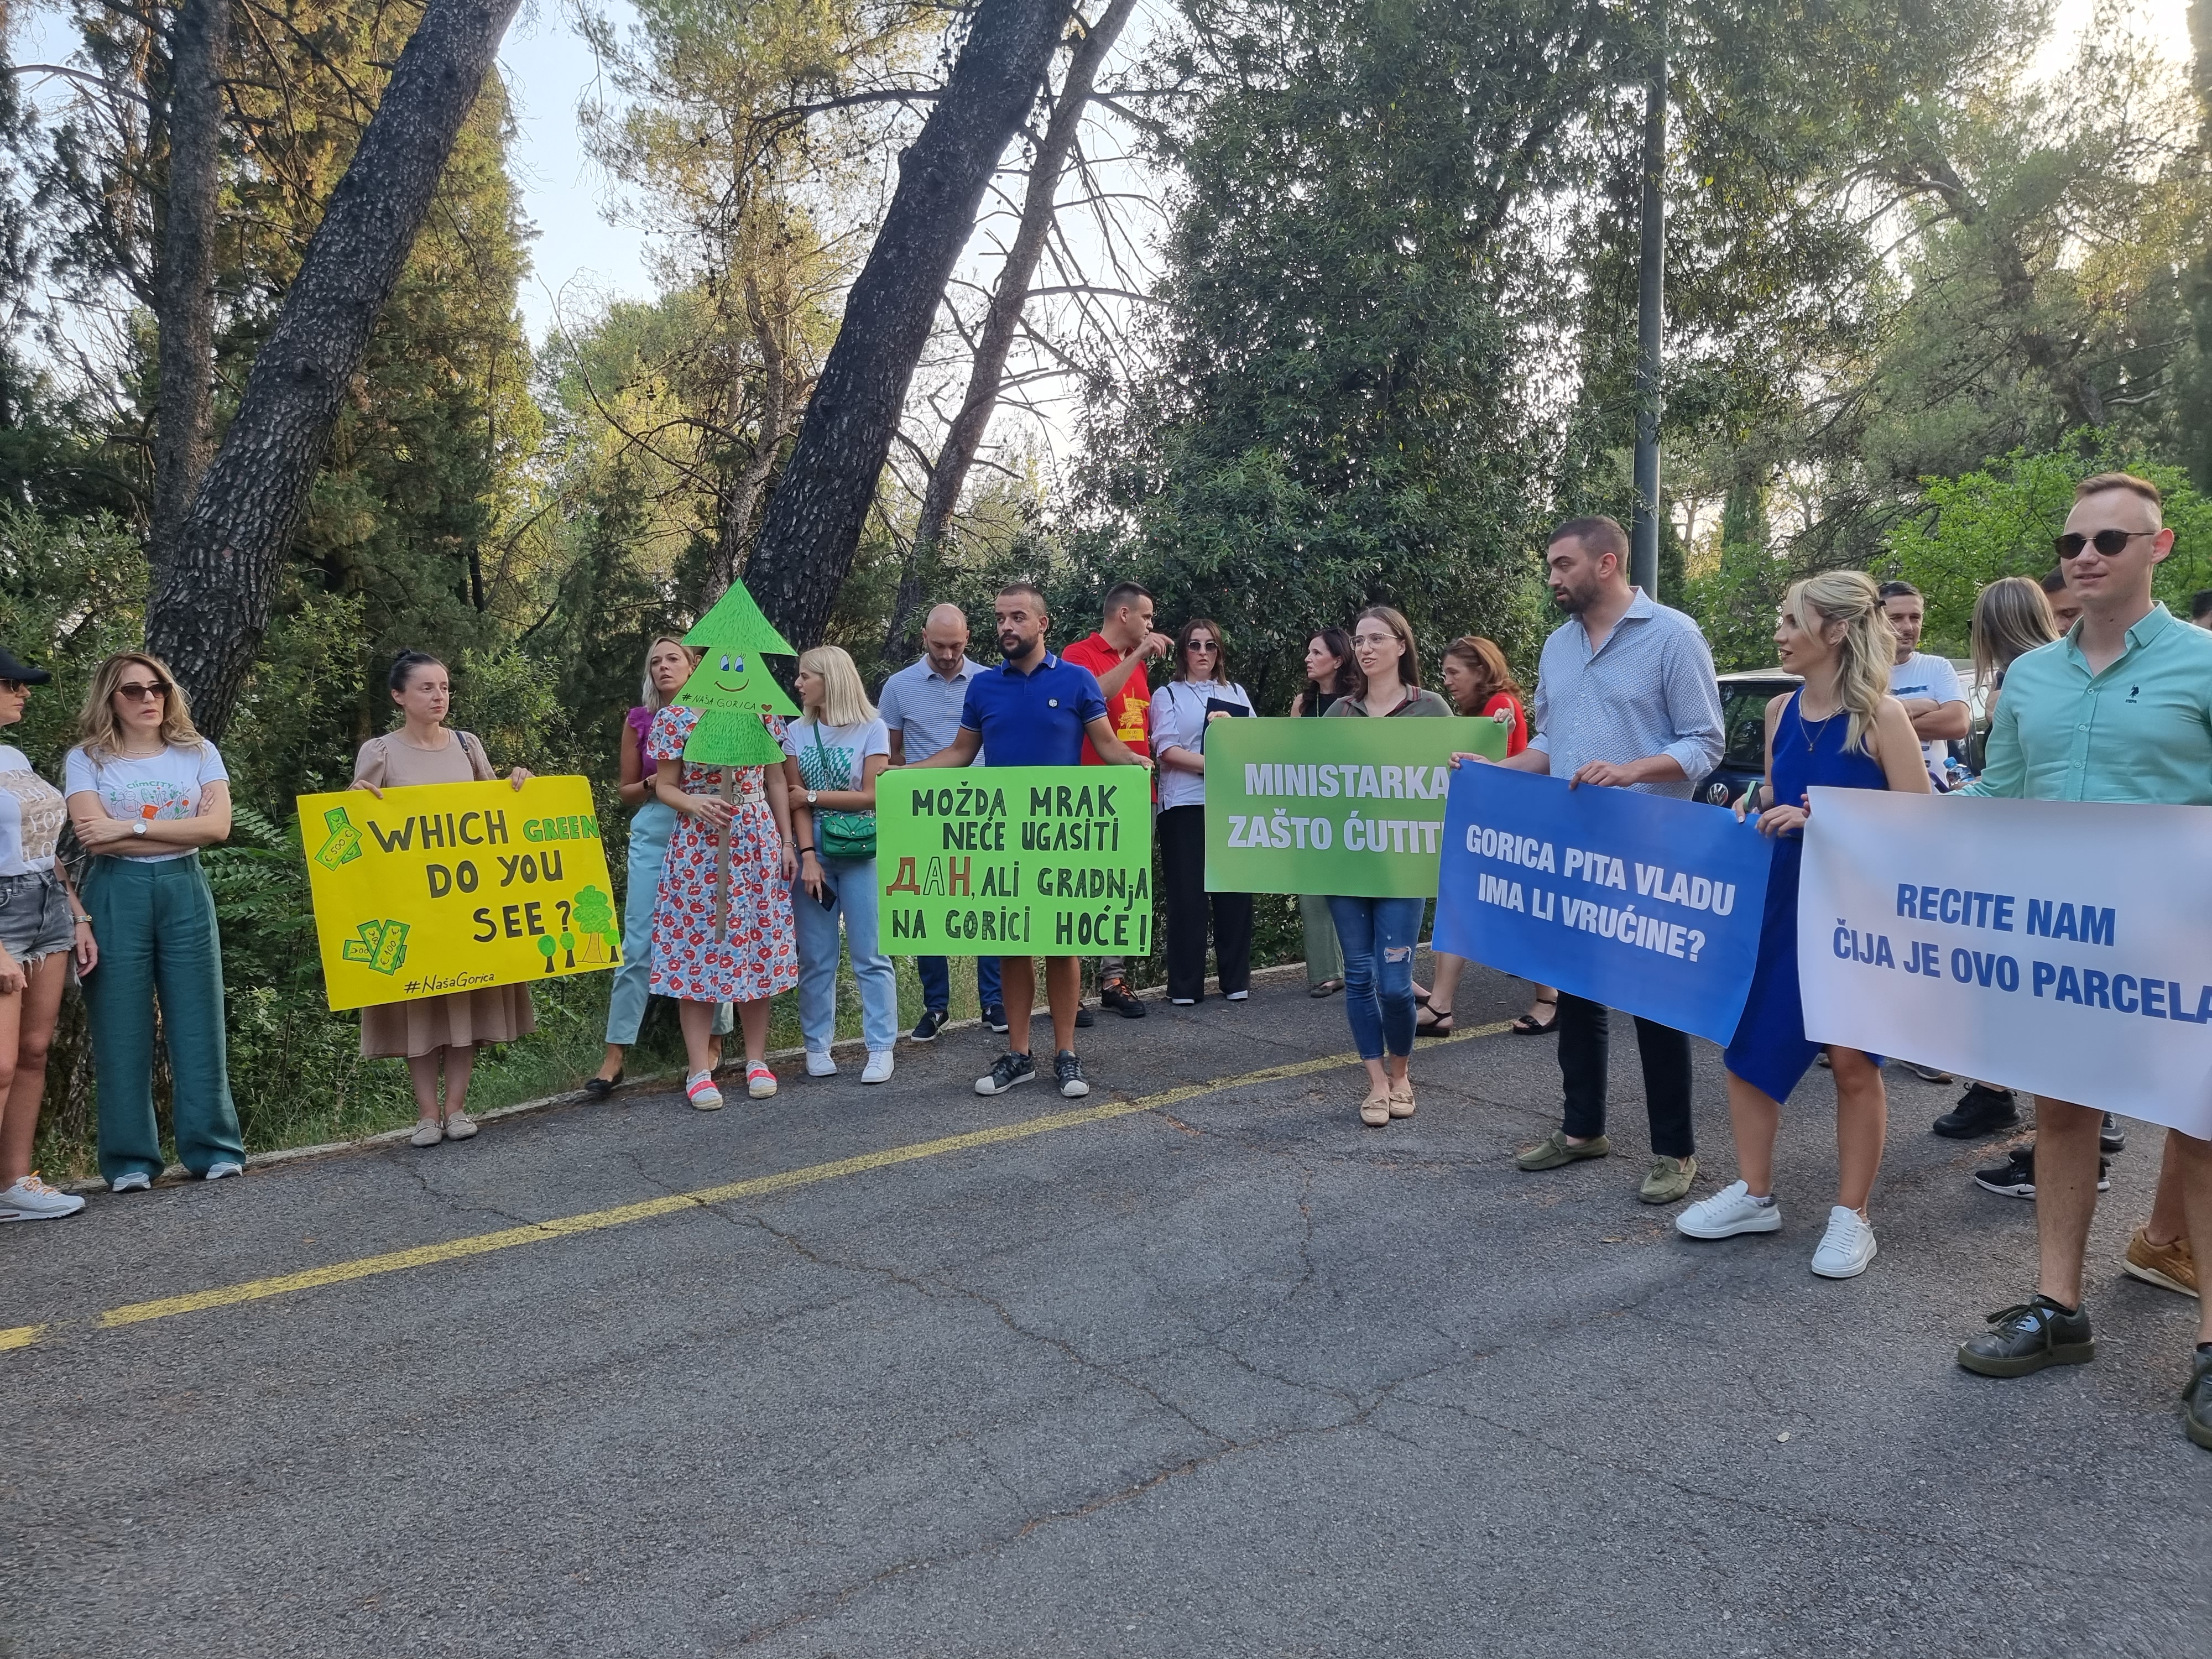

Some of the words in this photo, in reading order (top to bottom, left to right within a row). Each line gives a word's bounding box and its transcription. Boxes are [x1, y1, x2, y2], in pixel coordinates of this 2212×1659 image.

[717, 698, 756, 711] GORICA
[912, 781, 1007, 817] MOŽDA
[1030, 785, 1118, 817] MRAK
[1245, 763, 1450, 800] MINISTARKA
[331, 839, 346, 855] 500
[367, 810, 509, 853] WHICH
[523, 815, 599, 842] GREEN
[943, 816, 1005, 851] NEĆE
[1228, 808, 1332, 849] ZAŠTO
[1344, 810, 1444, 854] ĆUTIT
[426, 860, 478, 899] DO
[497, 850, 563, 887] YOU
[1466, 825, 1556, 874] GORICA
[1564, 847, 1626, 891] PITA
[1635, 863, 1735, 916] VLADU
[892, 910, 926, 938] NA
[1478, 873, 1525, 913] IMA
[1532, 888, 1554, 922] LI
[1562, 895, 1706, 963] VRUĆINE?
[1896, 883, 2015, 932] RECITE
[2026, 898, 2116, 947] NAM
[384, 940, 397, 956] 100
[1833, 918, 1896, 971] ČIJA
[1903, 941, 1941, 979] JE
[1951, 947, 2020, 993] OVO
[2032, 960, 2212, 1025] PARCELA
